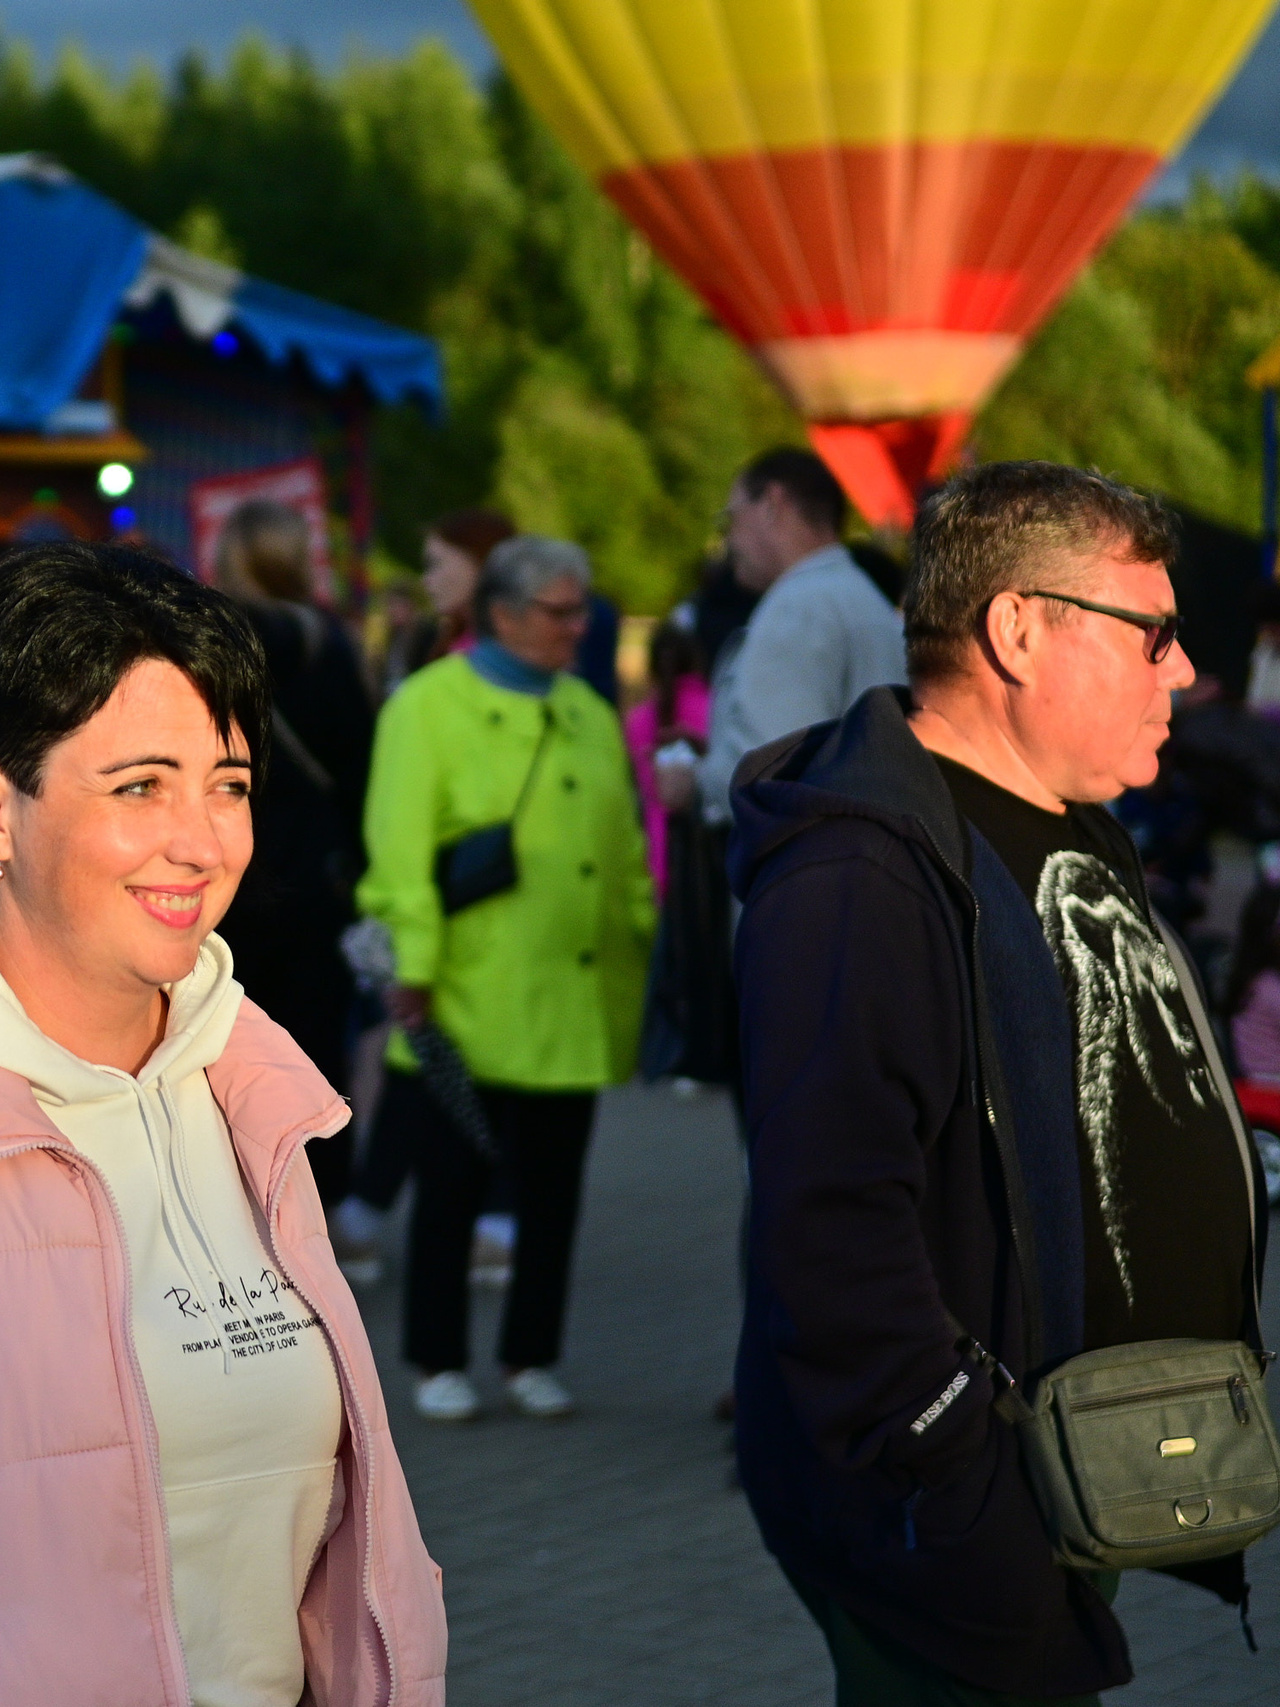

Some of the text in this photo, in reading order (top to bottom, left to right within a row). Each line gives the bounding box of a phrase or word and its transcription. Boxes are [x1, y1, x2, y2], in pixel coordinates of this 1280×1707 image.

[164, 1286, 214, 1318] Ru
[218, 1281, 238, 1314] de
[239, 1276, 261, 1308] la
[242, 1318, 252, 1329] M
[254, 1315, 264, 1326] IN
[263, 1311, 286, 1325] PARIS
[181, 1341, 204, 1354] FROM
[265, 1326, 277, 1337] TO
[277, 1321, 303, 1334] OPERA
[231, 1346, 248, 1359] THE
[248, 1344, 265, 1356] CITY
[277, 1336, 299, 1350] LOVE
